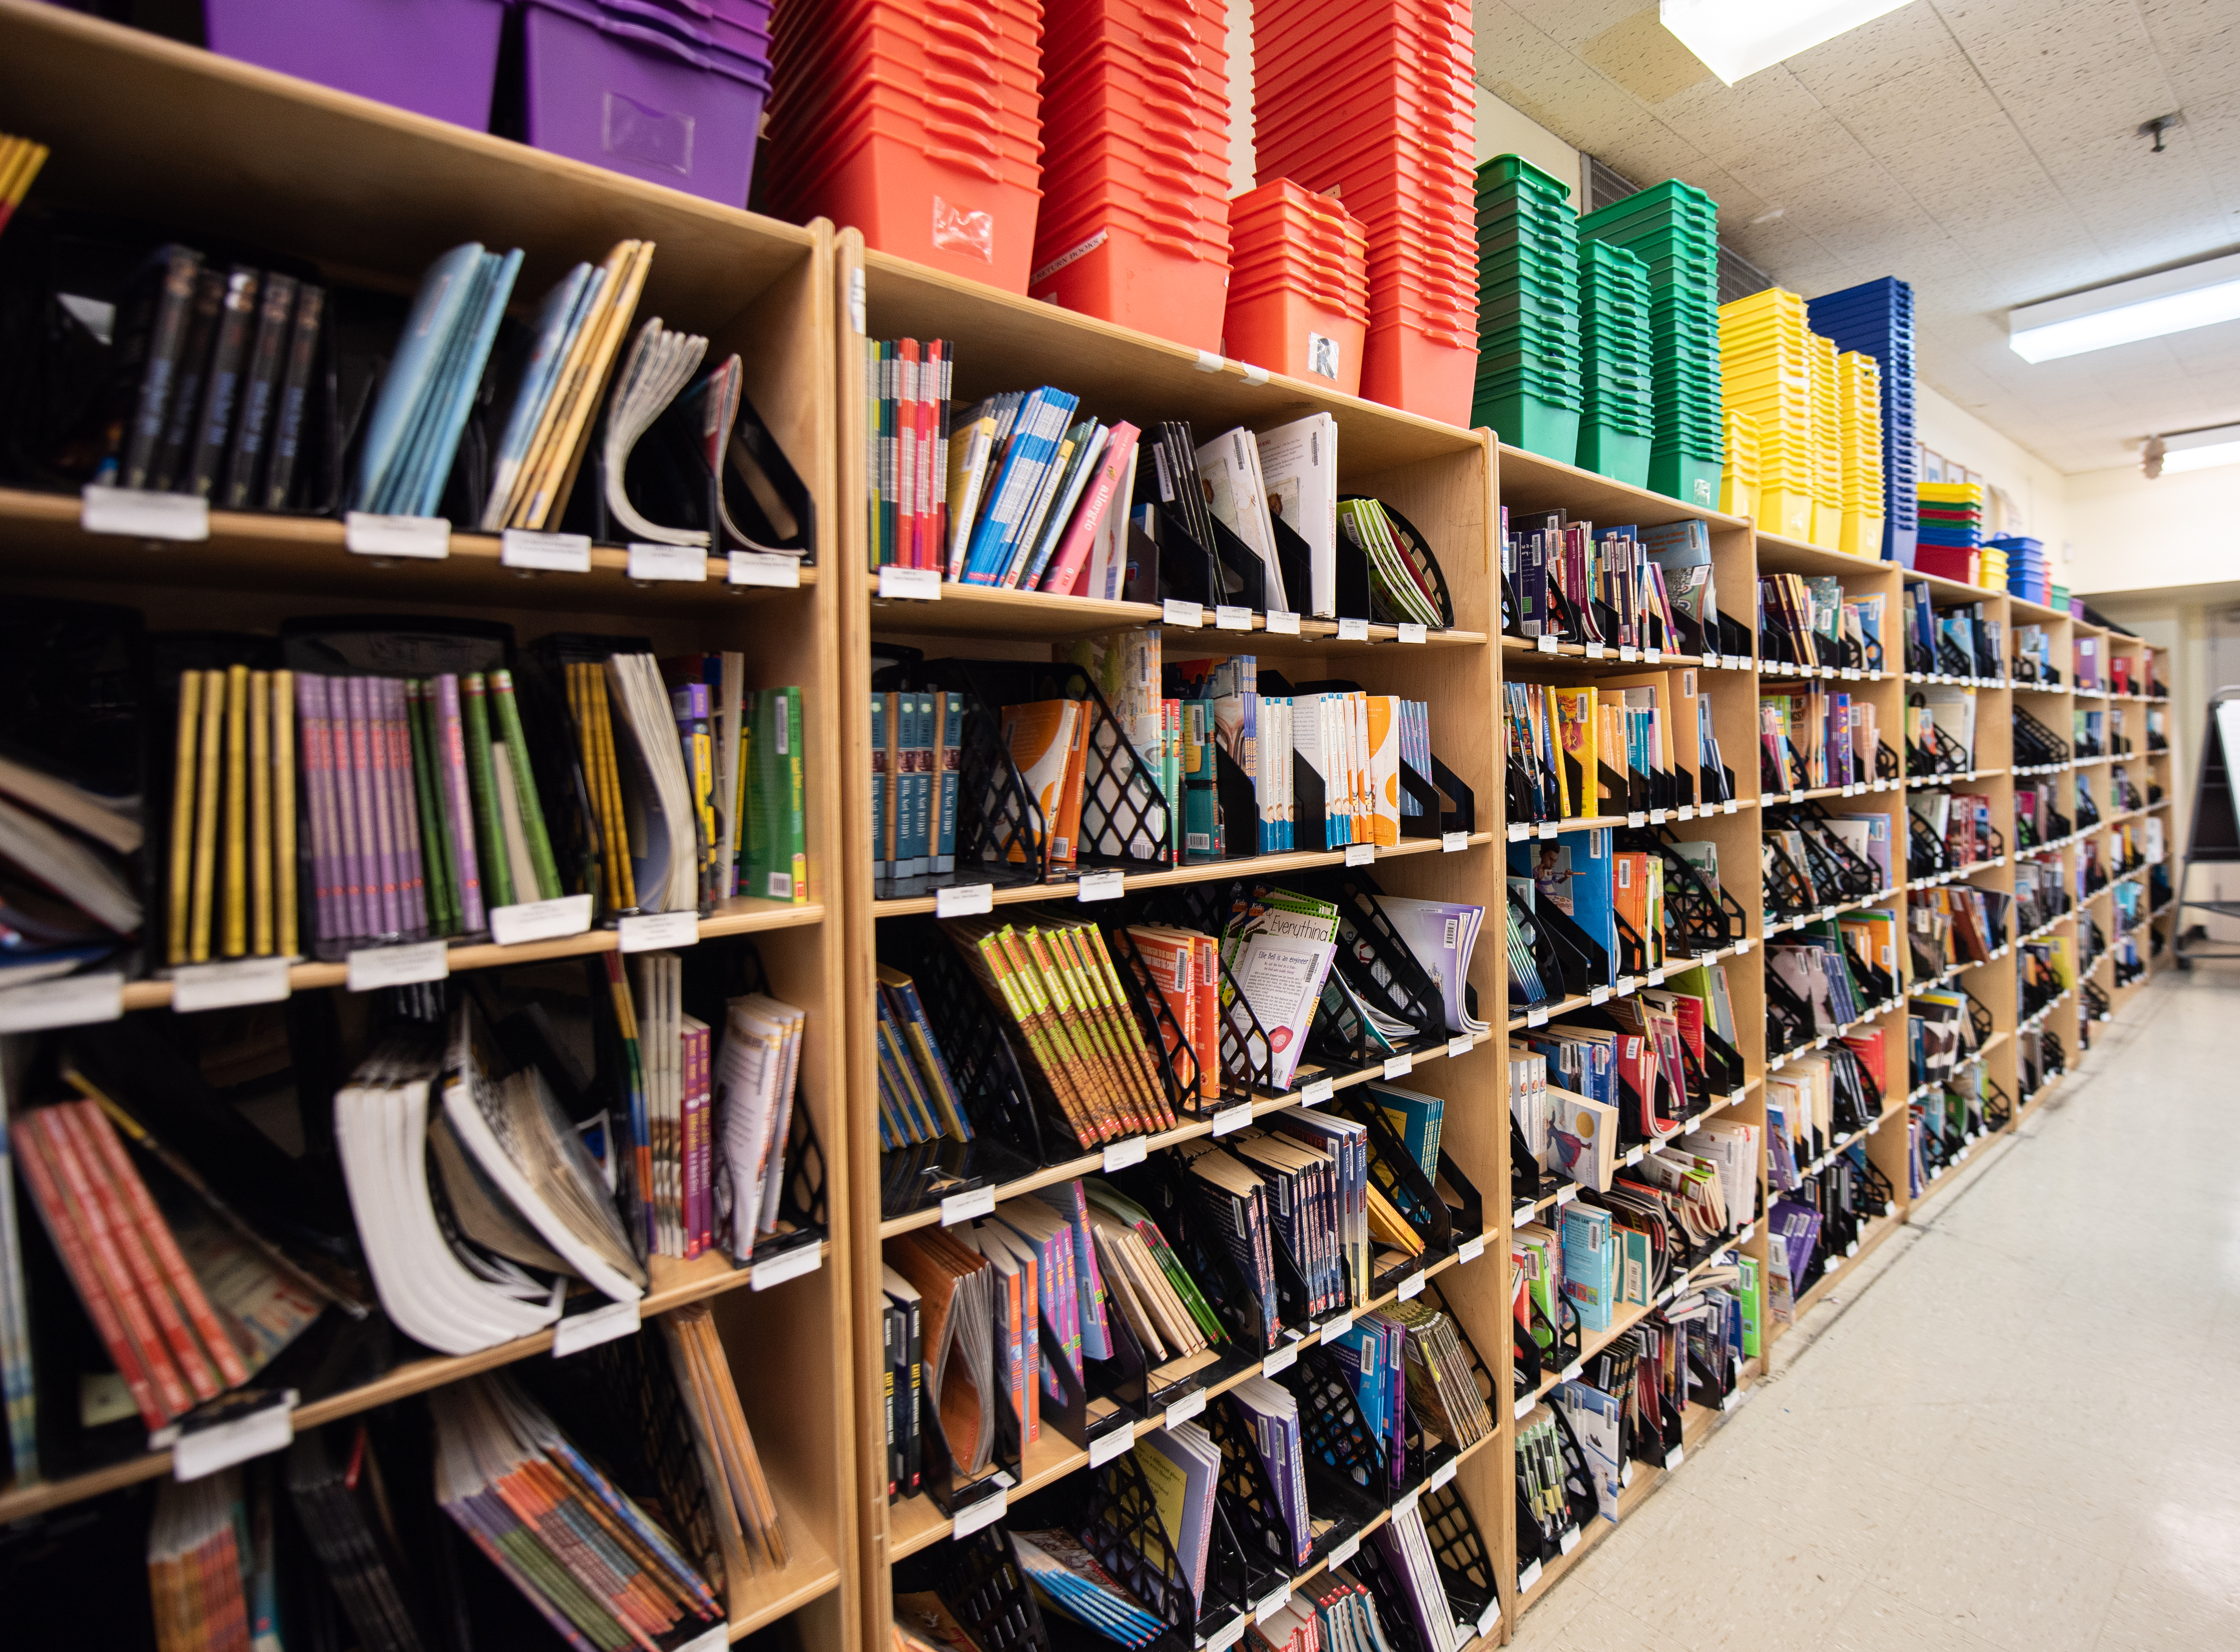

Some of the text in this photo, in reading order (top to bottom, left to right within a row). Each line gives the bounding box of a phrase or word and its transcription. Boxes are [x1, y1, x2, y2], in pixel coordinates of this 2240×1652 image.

[1084, 484, 1110, 532] allergic
[1542, 715, 1550, 740] AMULET
[901, 813, 909, 839] BUDDY
[916, 812, 926, 837] BUDDY
[943, 810, 953, 834] BUDDY
[1270, 914, 1329, 942] Everything
[1258, 951, 1267, 959] Ellie
[1288, 955, 1308, 967] engineer
[1326, 952, 1334, 968] PEARCE
[1306, 983, 1324, 1024] Ellie ENGINEER
[915, 1009, 936, 1049] BEVERLY CLEARY
[885, 1372, 893, 1396] EXIT 13
[911, 1364, 920, 1388] EXIT 13
